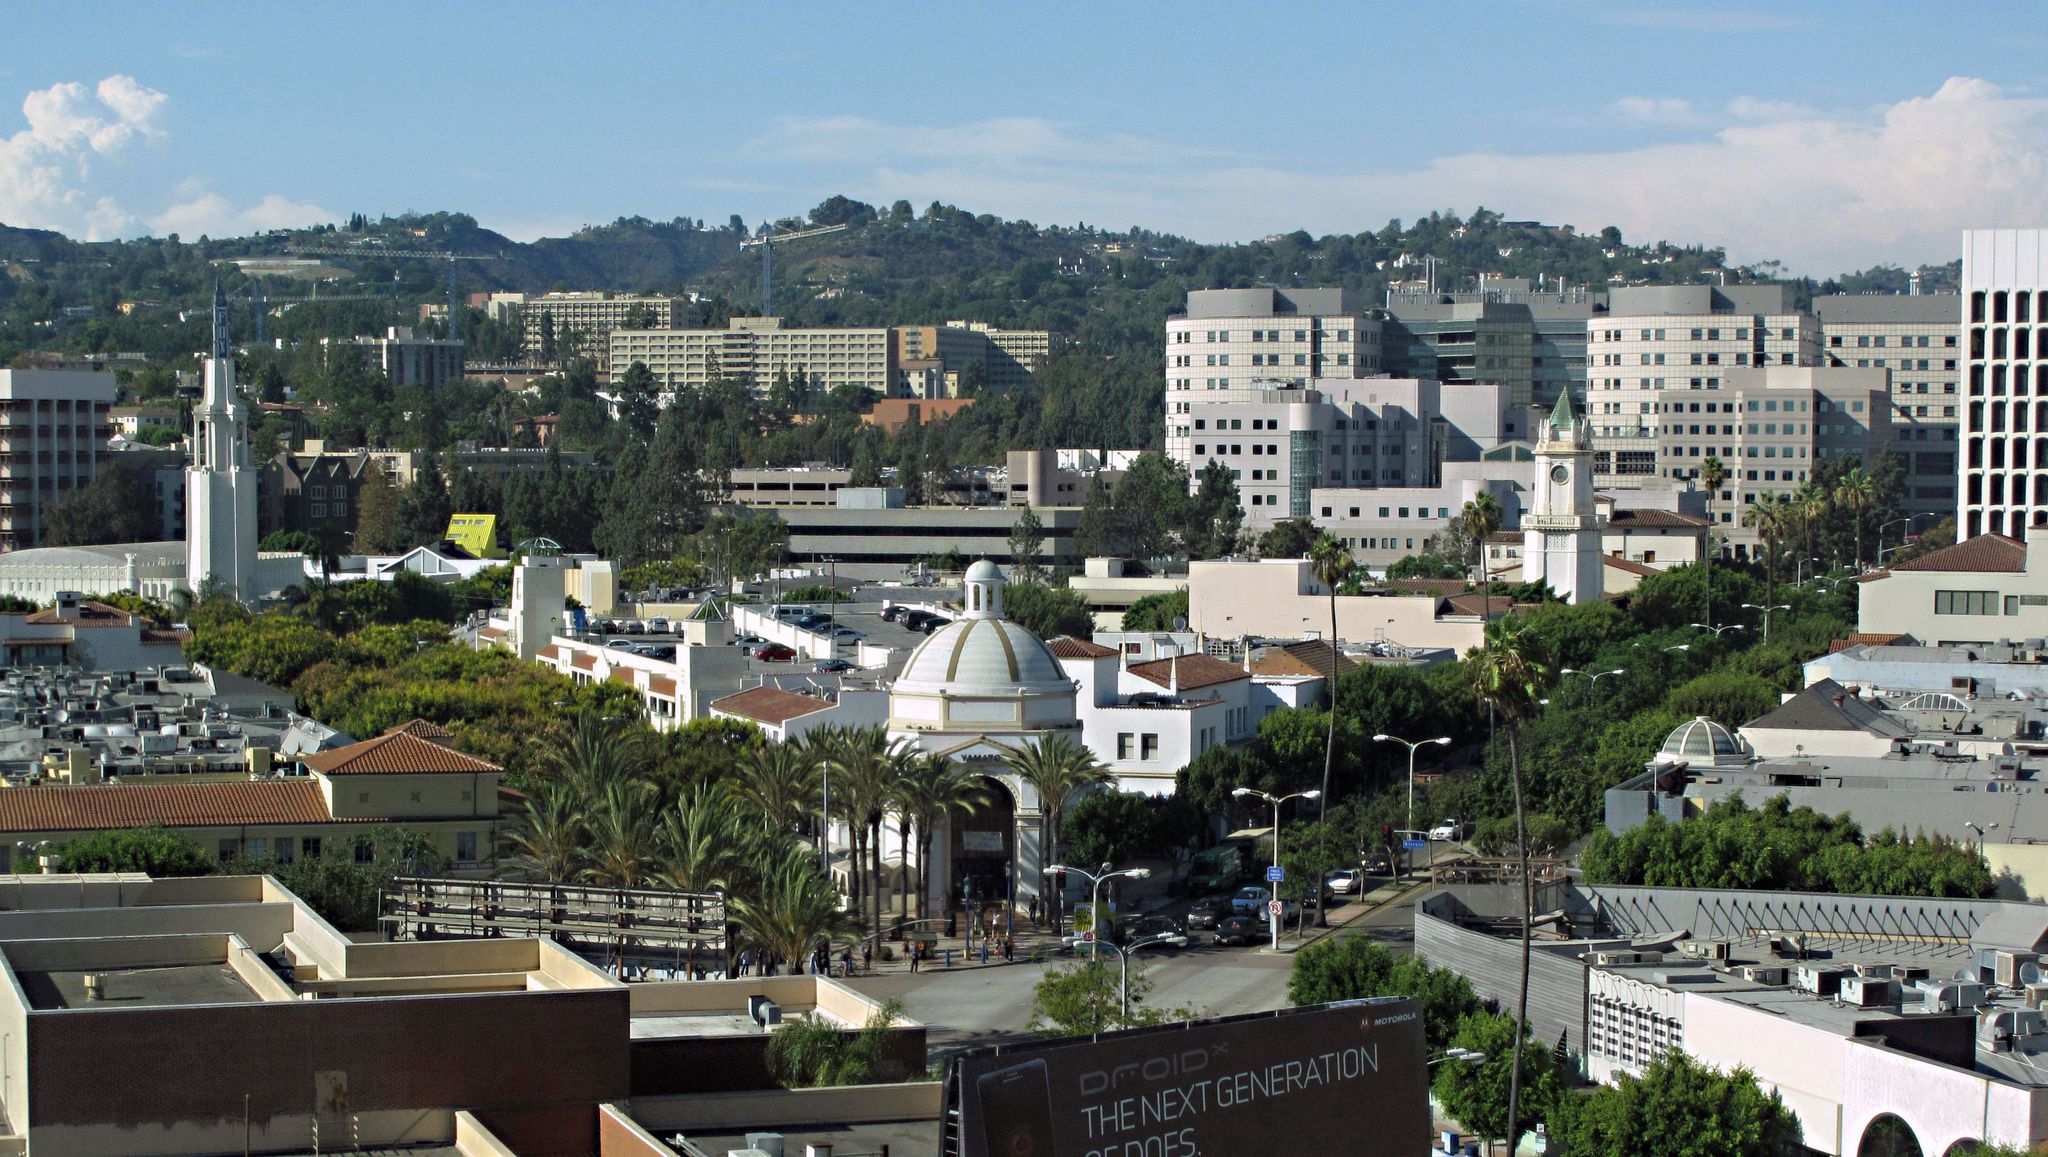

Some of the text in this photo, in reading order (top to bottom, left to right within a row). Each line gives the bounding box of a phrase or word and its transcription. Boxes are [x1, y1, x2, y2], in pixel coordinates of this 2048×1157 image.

[218, 310, 227, 354] FOX
[961, 754, 1001, 762] YAMATO
[1374, 1012, 1417, 1026] MOTOROLA
[1079, 1049, 1209, 1096] DROID
[1080, 1043, 1379, 1139] THE NEXT GENERATION
